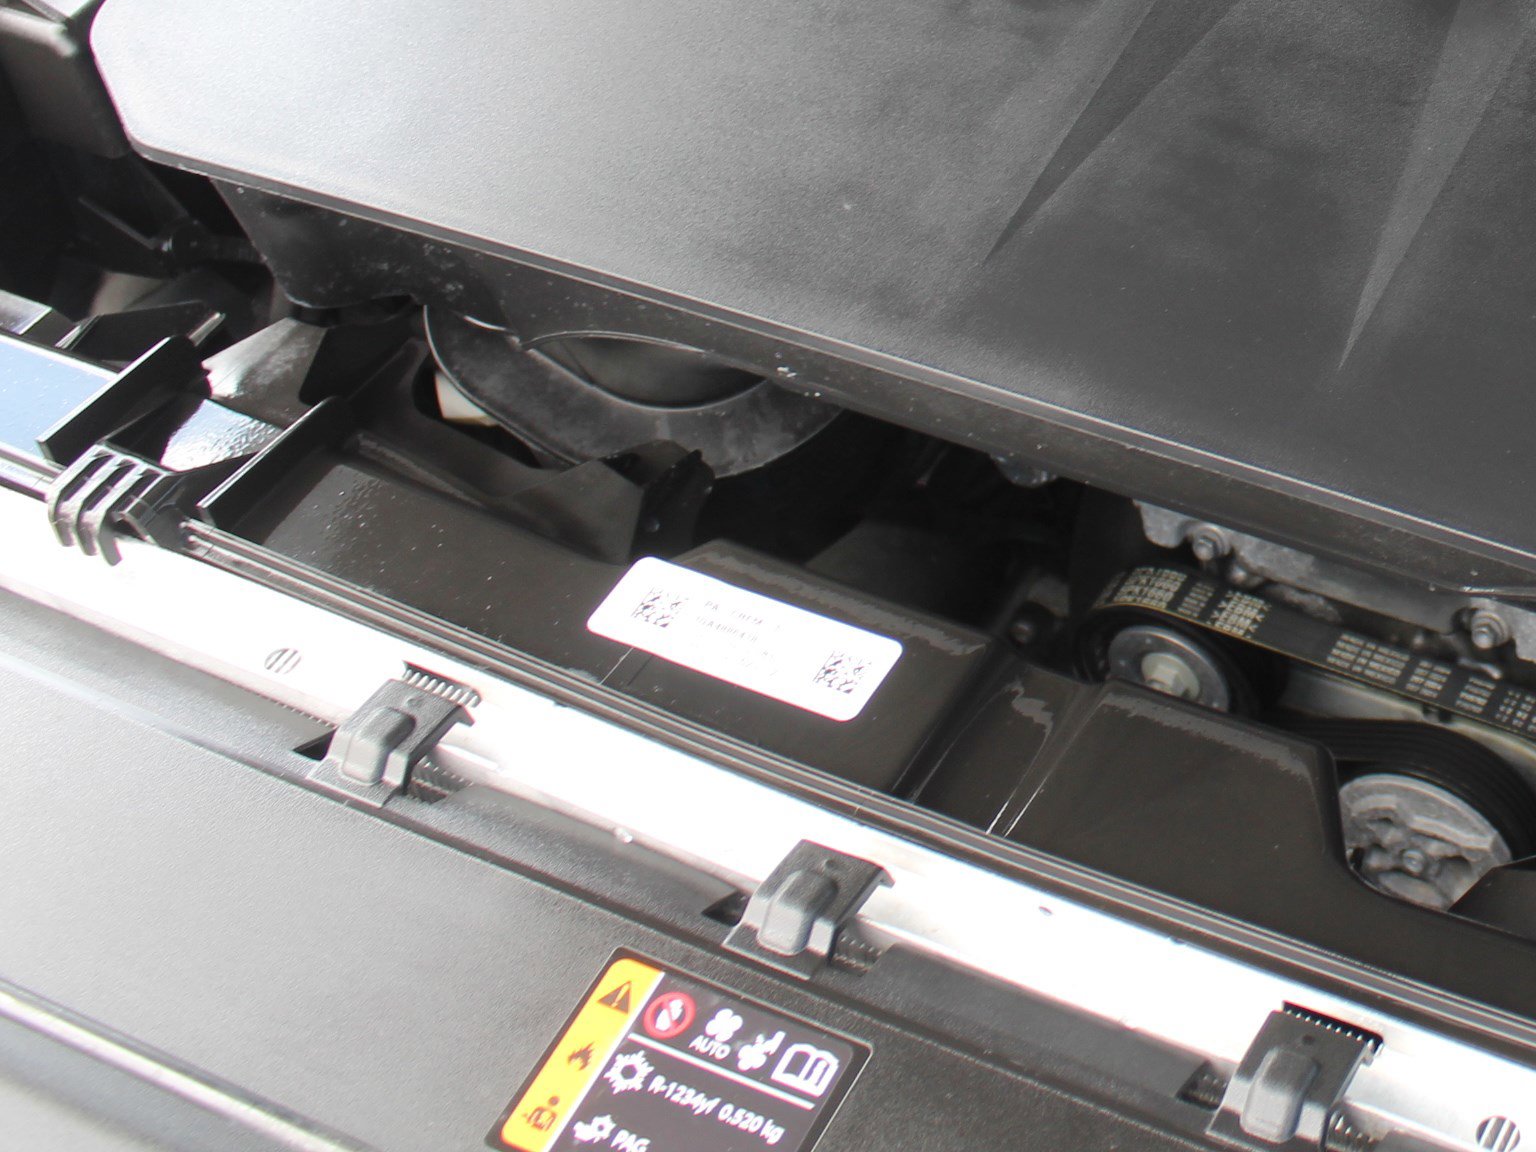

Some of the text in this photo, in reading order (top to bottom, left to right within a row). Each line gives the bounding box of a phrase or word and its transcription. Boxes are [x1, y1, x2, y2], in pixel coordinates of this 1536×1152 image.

[688, 1035, 731, 1060] AUTO
[648, 1075, 721, 1116] R-1234yf
[759, 1118, 786, 1145] kg
[610, 1129, 651, 1152] PAG
